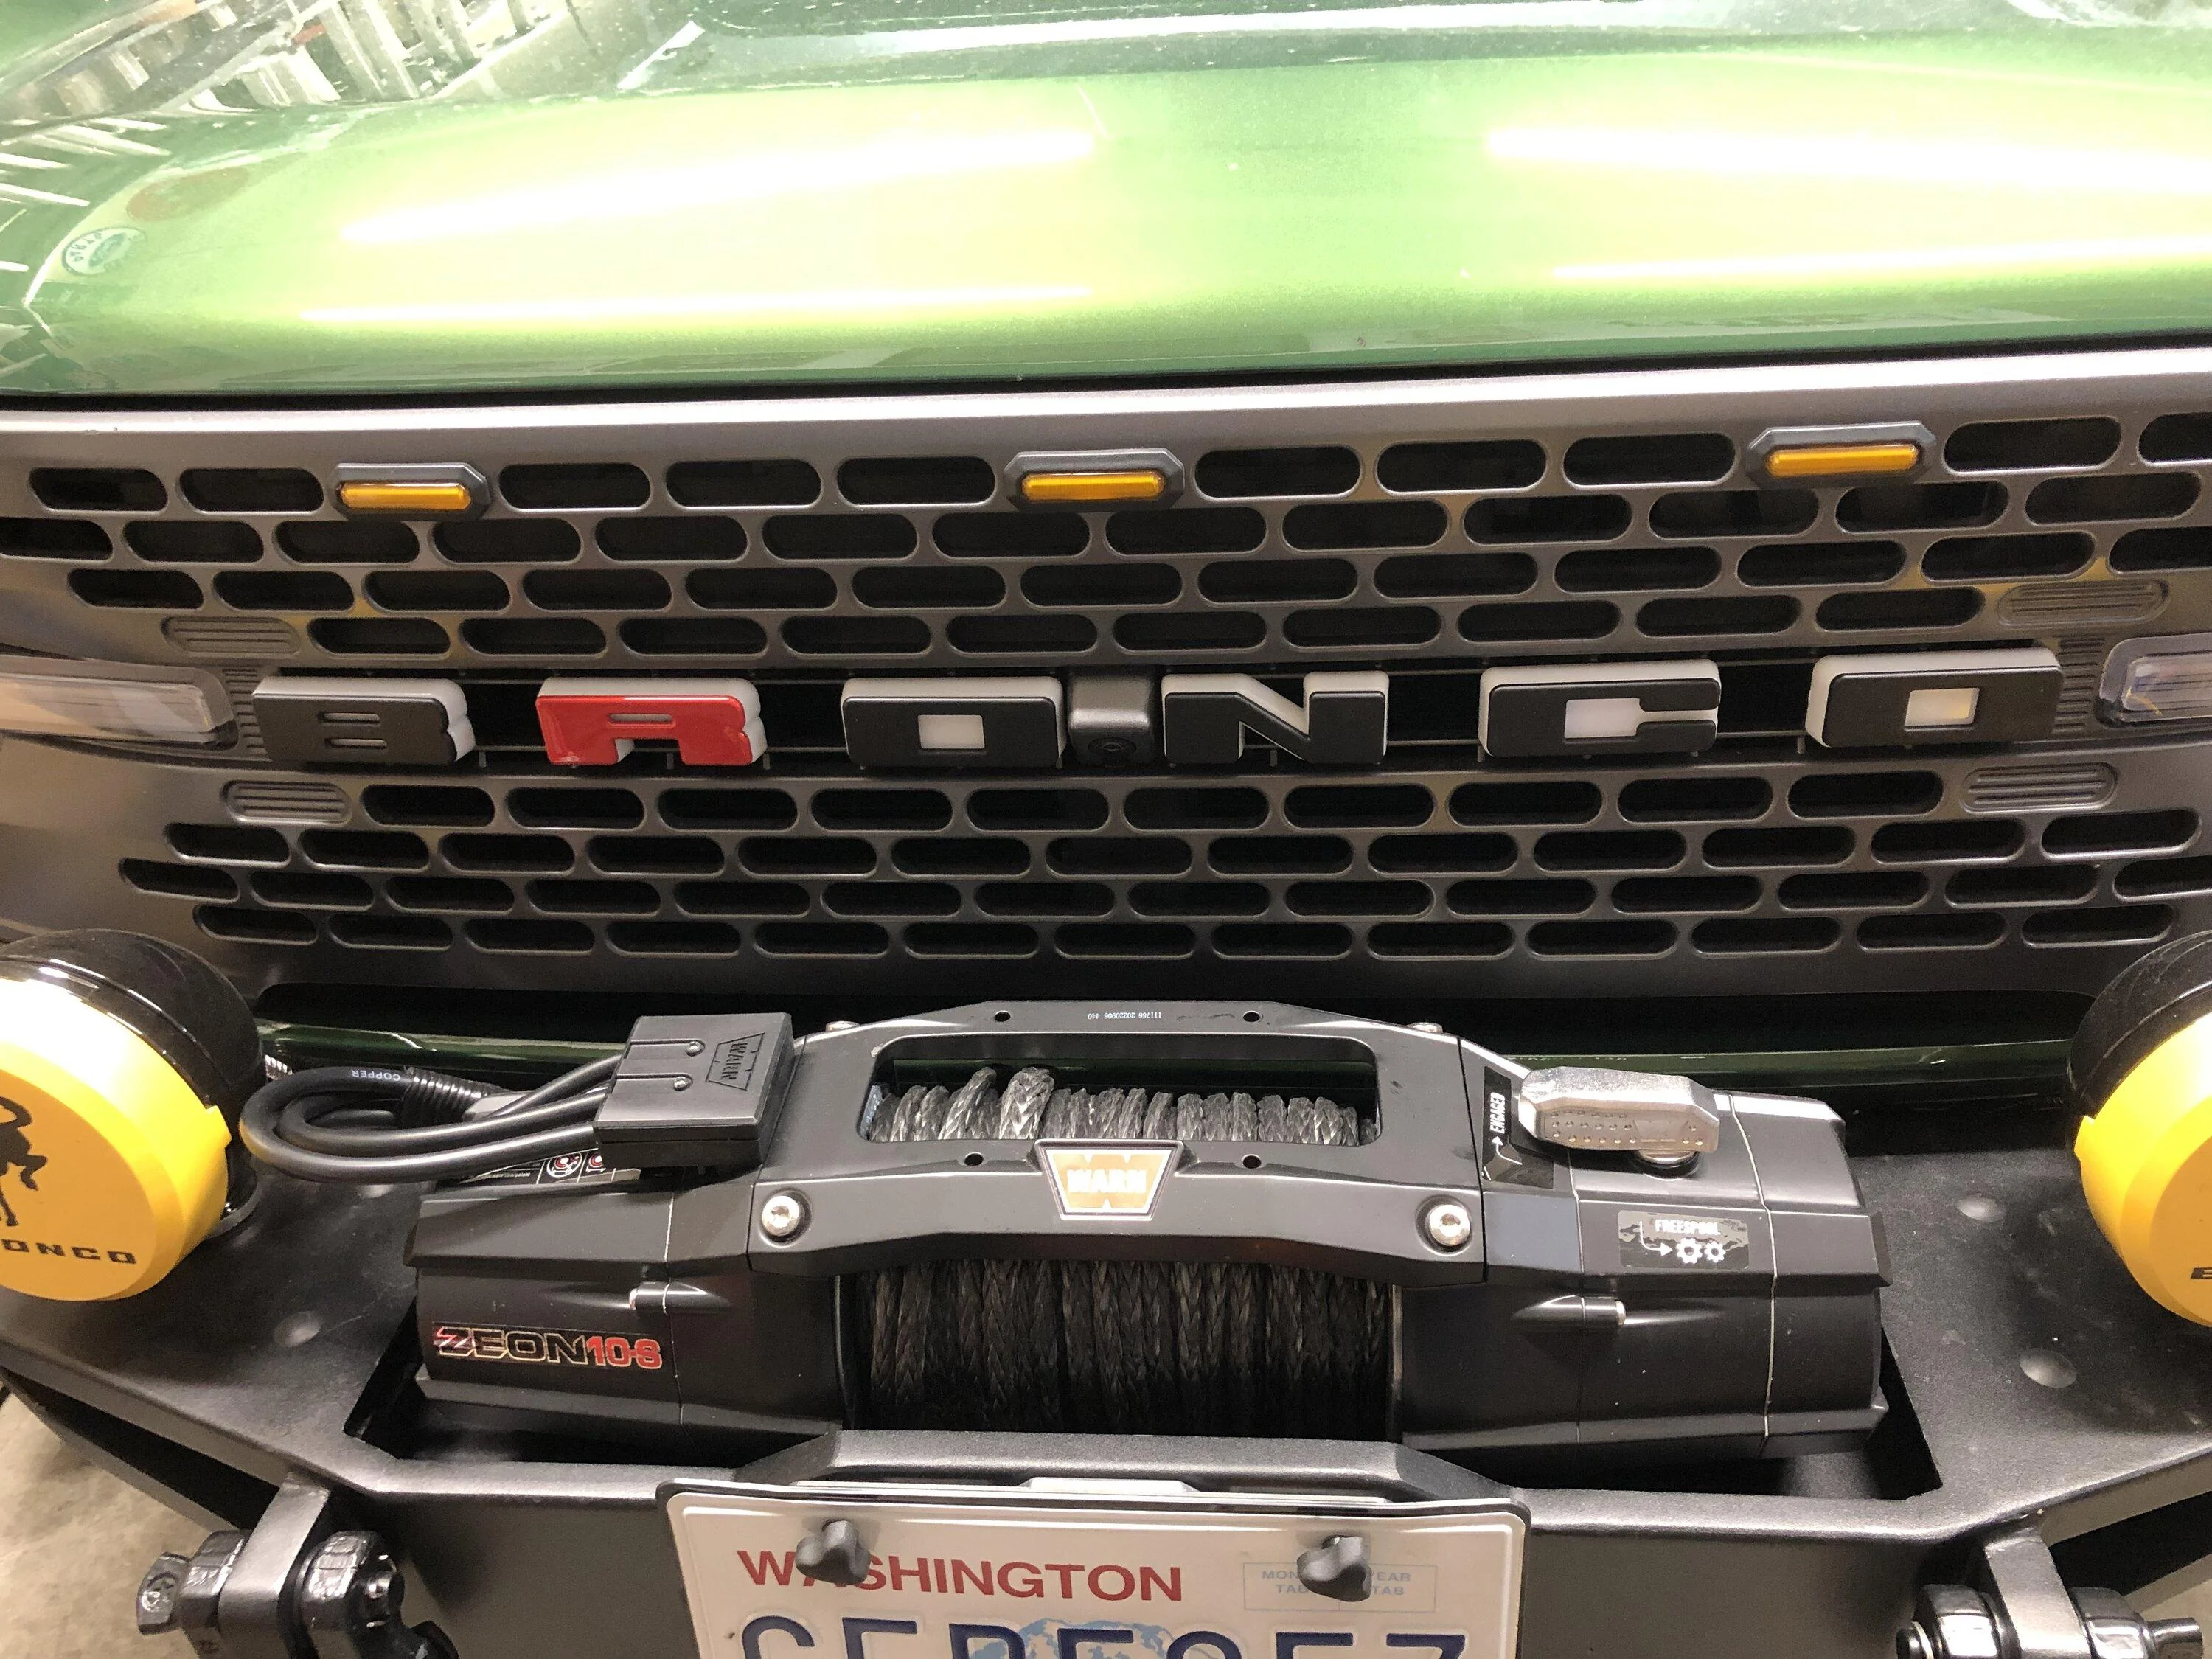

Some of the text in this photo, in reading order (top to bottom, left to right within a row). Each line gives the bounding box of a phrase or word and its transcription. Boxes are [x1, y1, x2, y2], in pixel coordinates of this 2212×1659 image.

[252, 648, 2062, 767] BRONCO
[720, 1041, 748, 1080] WARN
[351, 1069, 401, 1082] COPPER
[1489, 1092, 1506, 1134] ENGAGED
[1067, 1169, 1147, 1193] WARN
[1655, 1219, 1721, 1236] FREESPOOL
[737, 1550, 1183, 1601] WSHINGTON
[1262, 1570, 1299, 1581] MON
[1370, 1571, 1411, 1582] EAR
